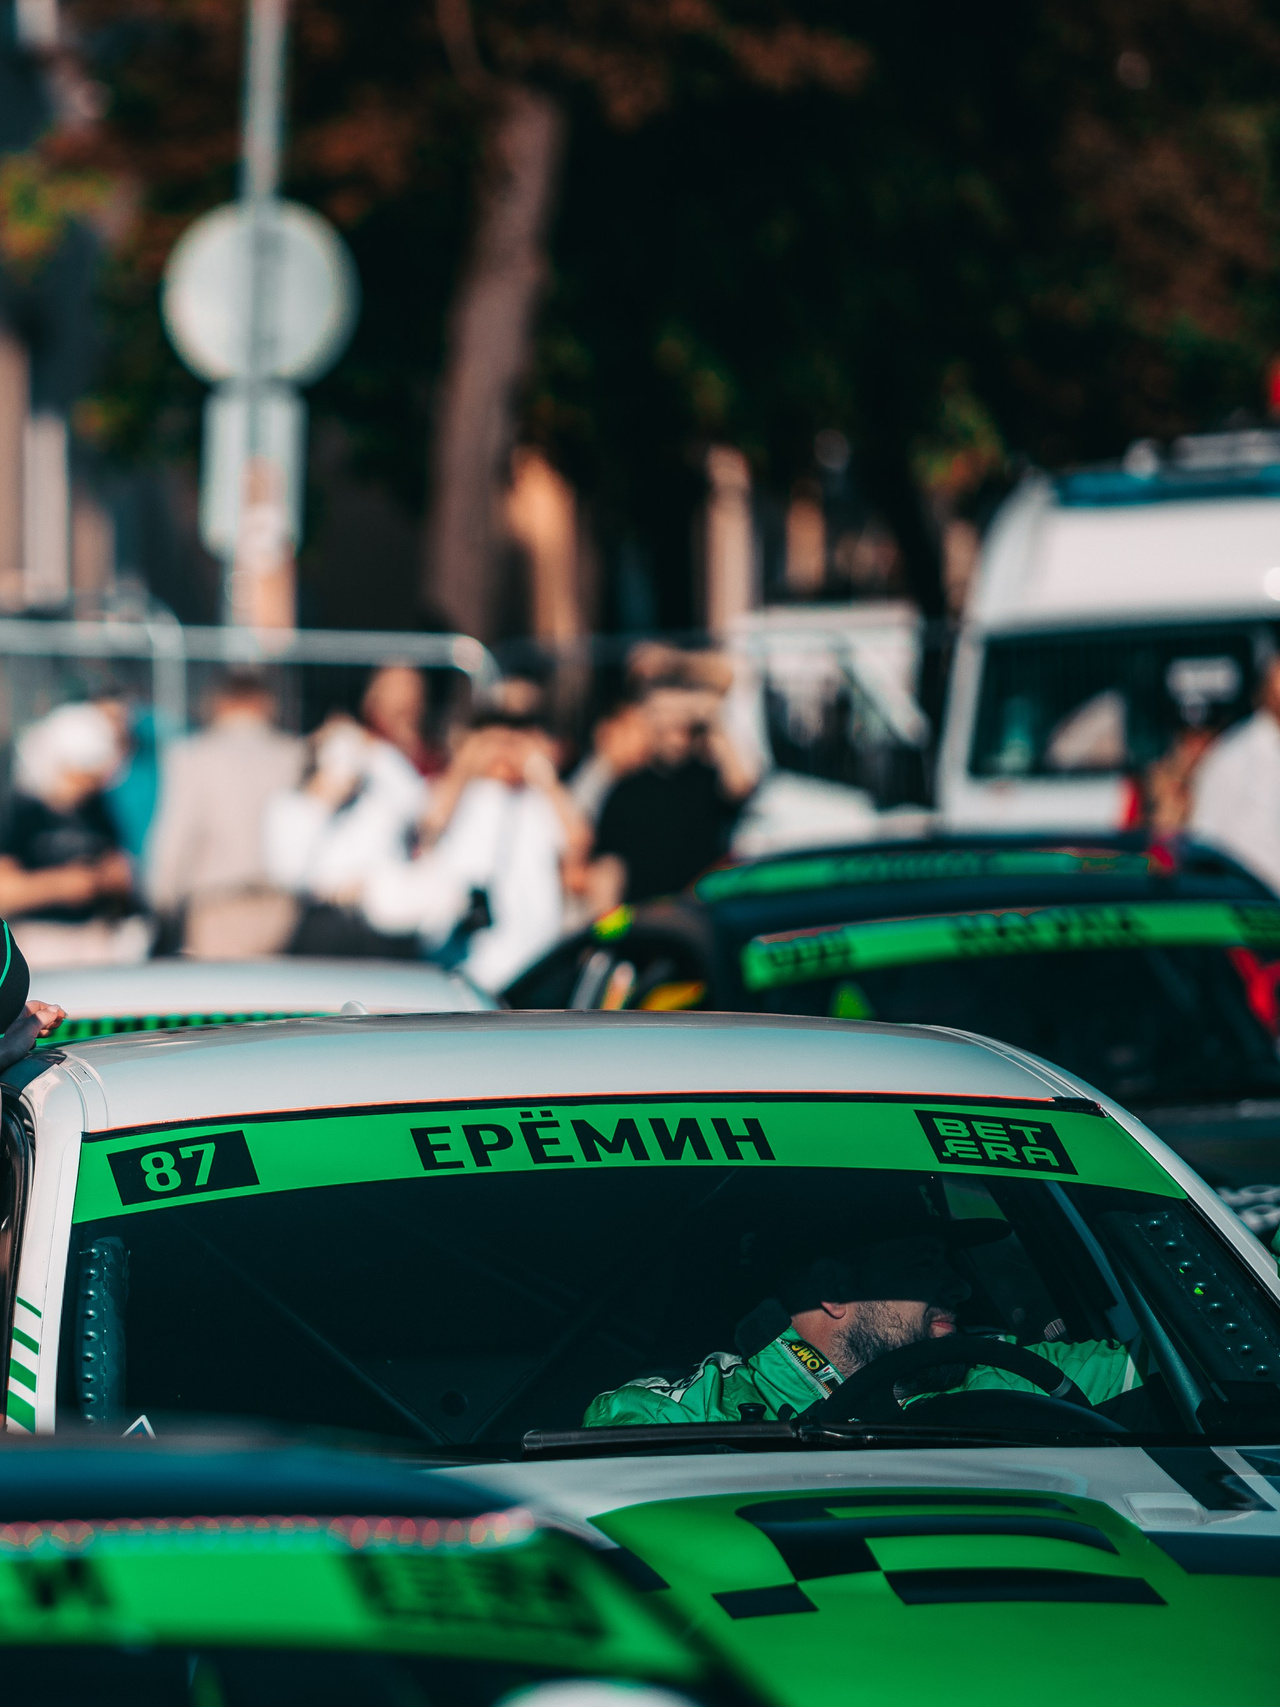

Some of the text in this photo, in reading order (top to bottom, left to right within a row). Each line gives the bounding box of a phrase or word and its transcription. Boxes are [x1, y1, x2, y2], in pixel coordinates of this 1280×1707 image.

[410, 1110, 776, 1170] ЕРЁМИН
[932, 1117, 1041, 1145] BET
[140, 1142, 216, 1192] 87
[942, 1139, 1060, 1167] ERA
